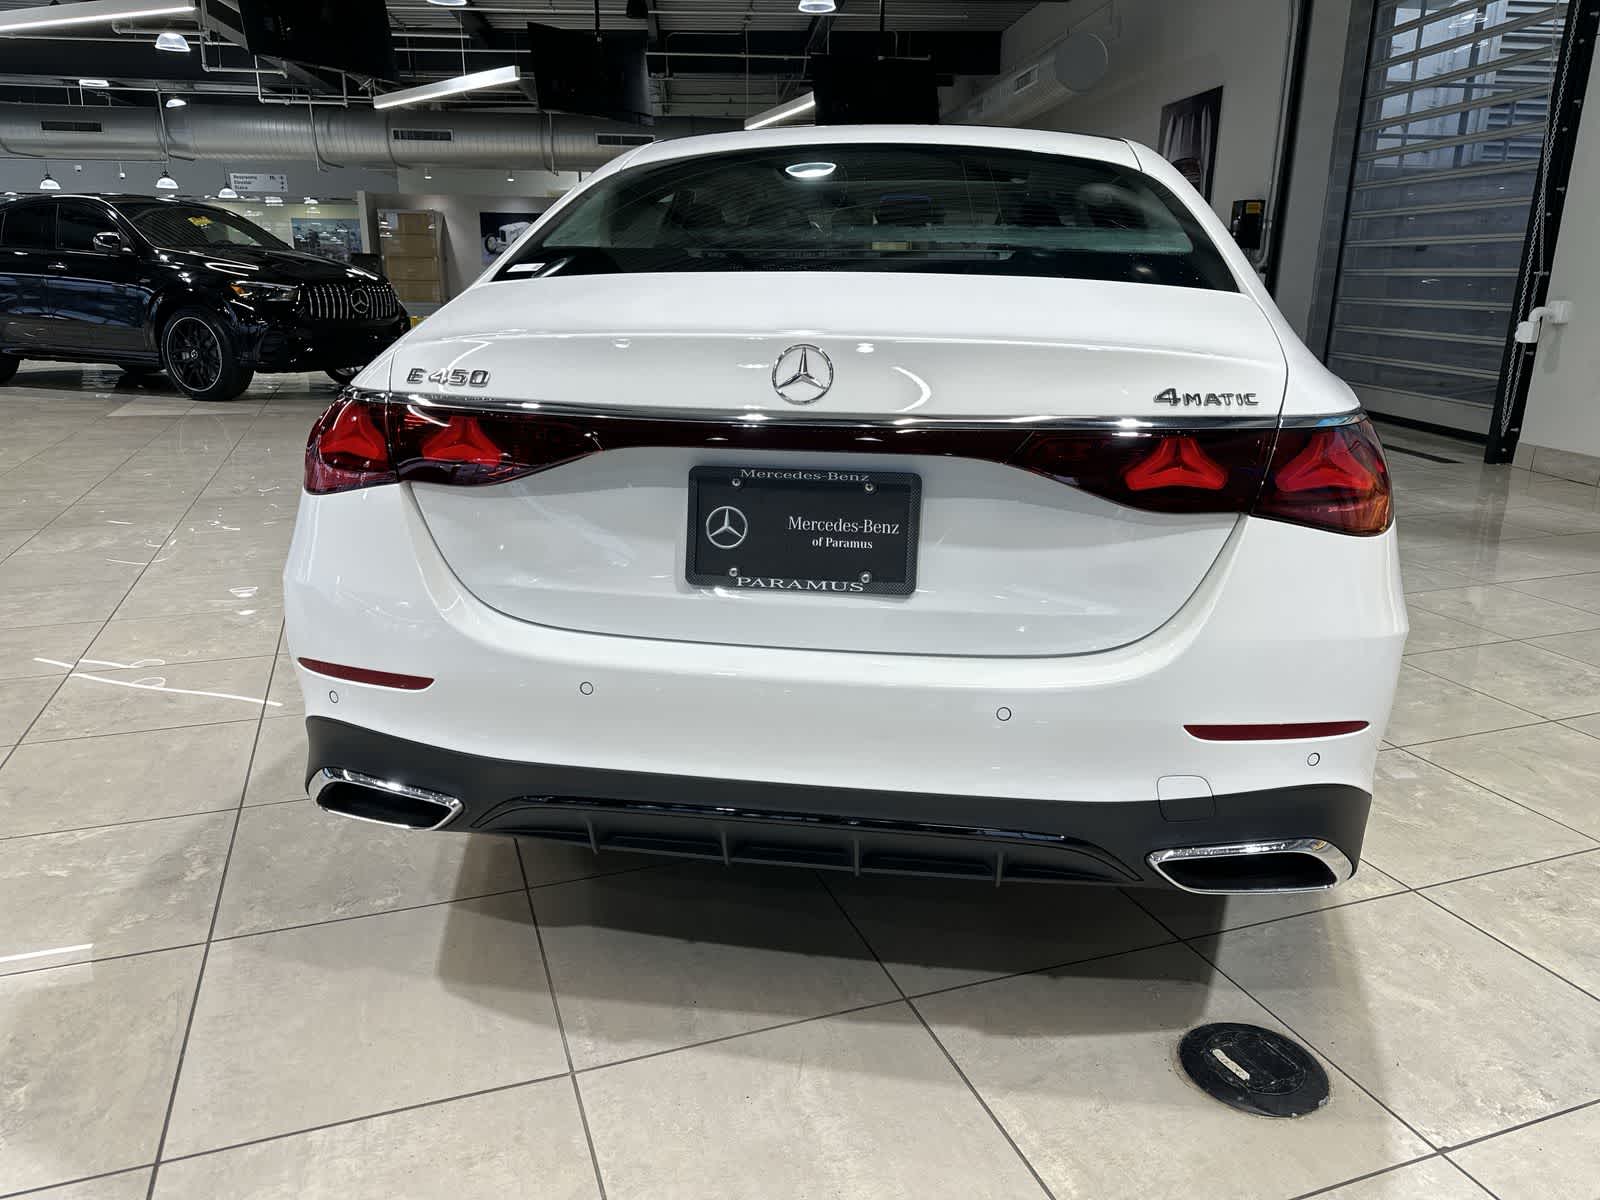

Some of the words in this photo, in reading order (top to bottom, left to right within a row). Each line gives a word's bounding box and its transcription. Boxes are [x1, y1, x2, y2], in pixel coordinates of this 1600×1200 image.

[406, 368, 427, 384] E
[428, 368, 491, 388] 450
[1153, 388, 1259, 406] 4MATIC
[740, 469, 870, 482] Mercedes-Benz
[788, 516, 900, 535] Mercedes-Benz
[812, 537, 823, 548] of
[826, 537, 873, 549] Paramus
[736, 576, 864, 592] PARAMUS
